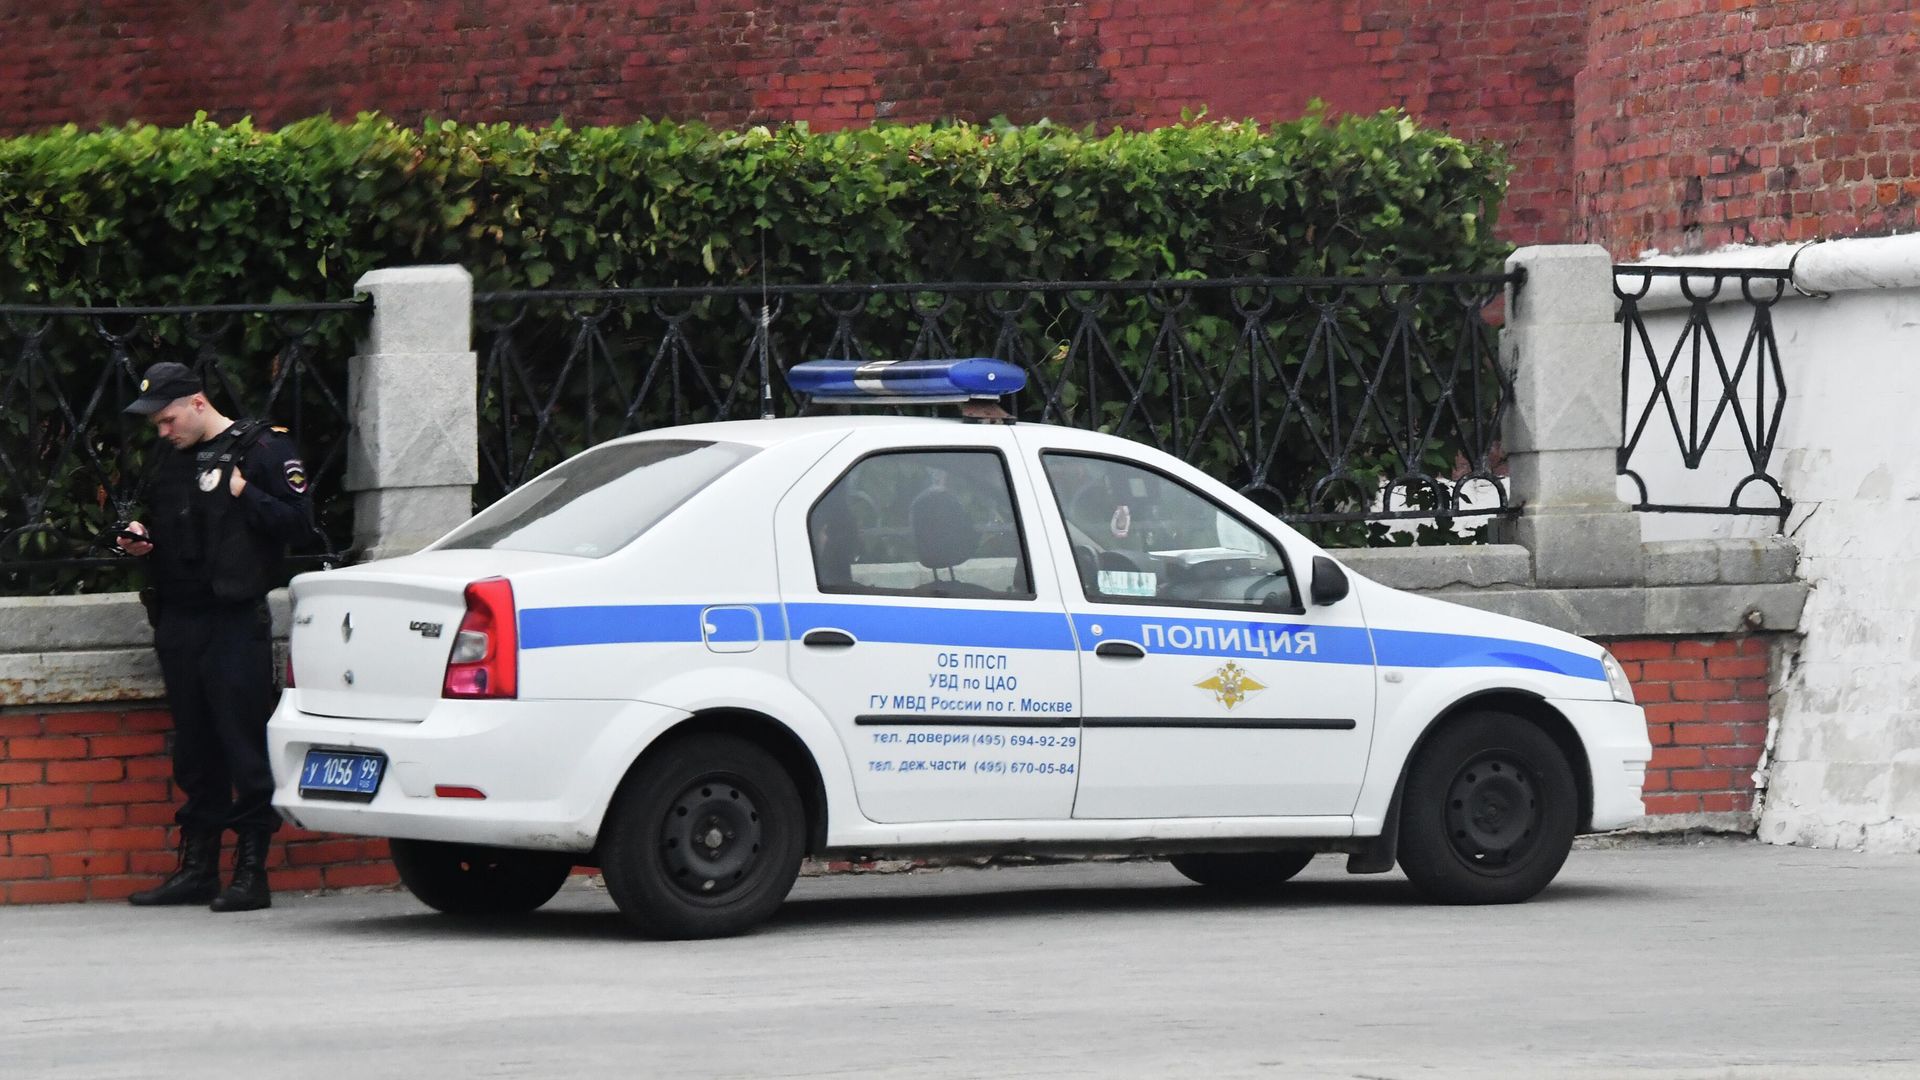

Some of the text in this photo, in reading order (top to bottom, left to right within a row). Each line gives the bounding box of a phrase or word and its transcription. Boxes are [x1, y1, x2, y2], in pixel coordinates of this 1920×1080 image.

[1141, 624, 1317, 657] ПОЛИЦИЯ
[937, 653, 1007, 670] ОБ ППСП
[929, 673, 1017, 692] УВД по ЦАО
[870, 695, 1072, 713] ГУ МВД России по г. Москве
[873, 733, 1076, 748] тел. доверия (495) 694-92-29
[322, 758, 354, 785] 1056
[360, 759, 378, 779] 99
[868, 761, 895, 771] тел.
[974, 760, 1006, 774] (495)
[1011, 761, 1075, 774] 670-05-84
